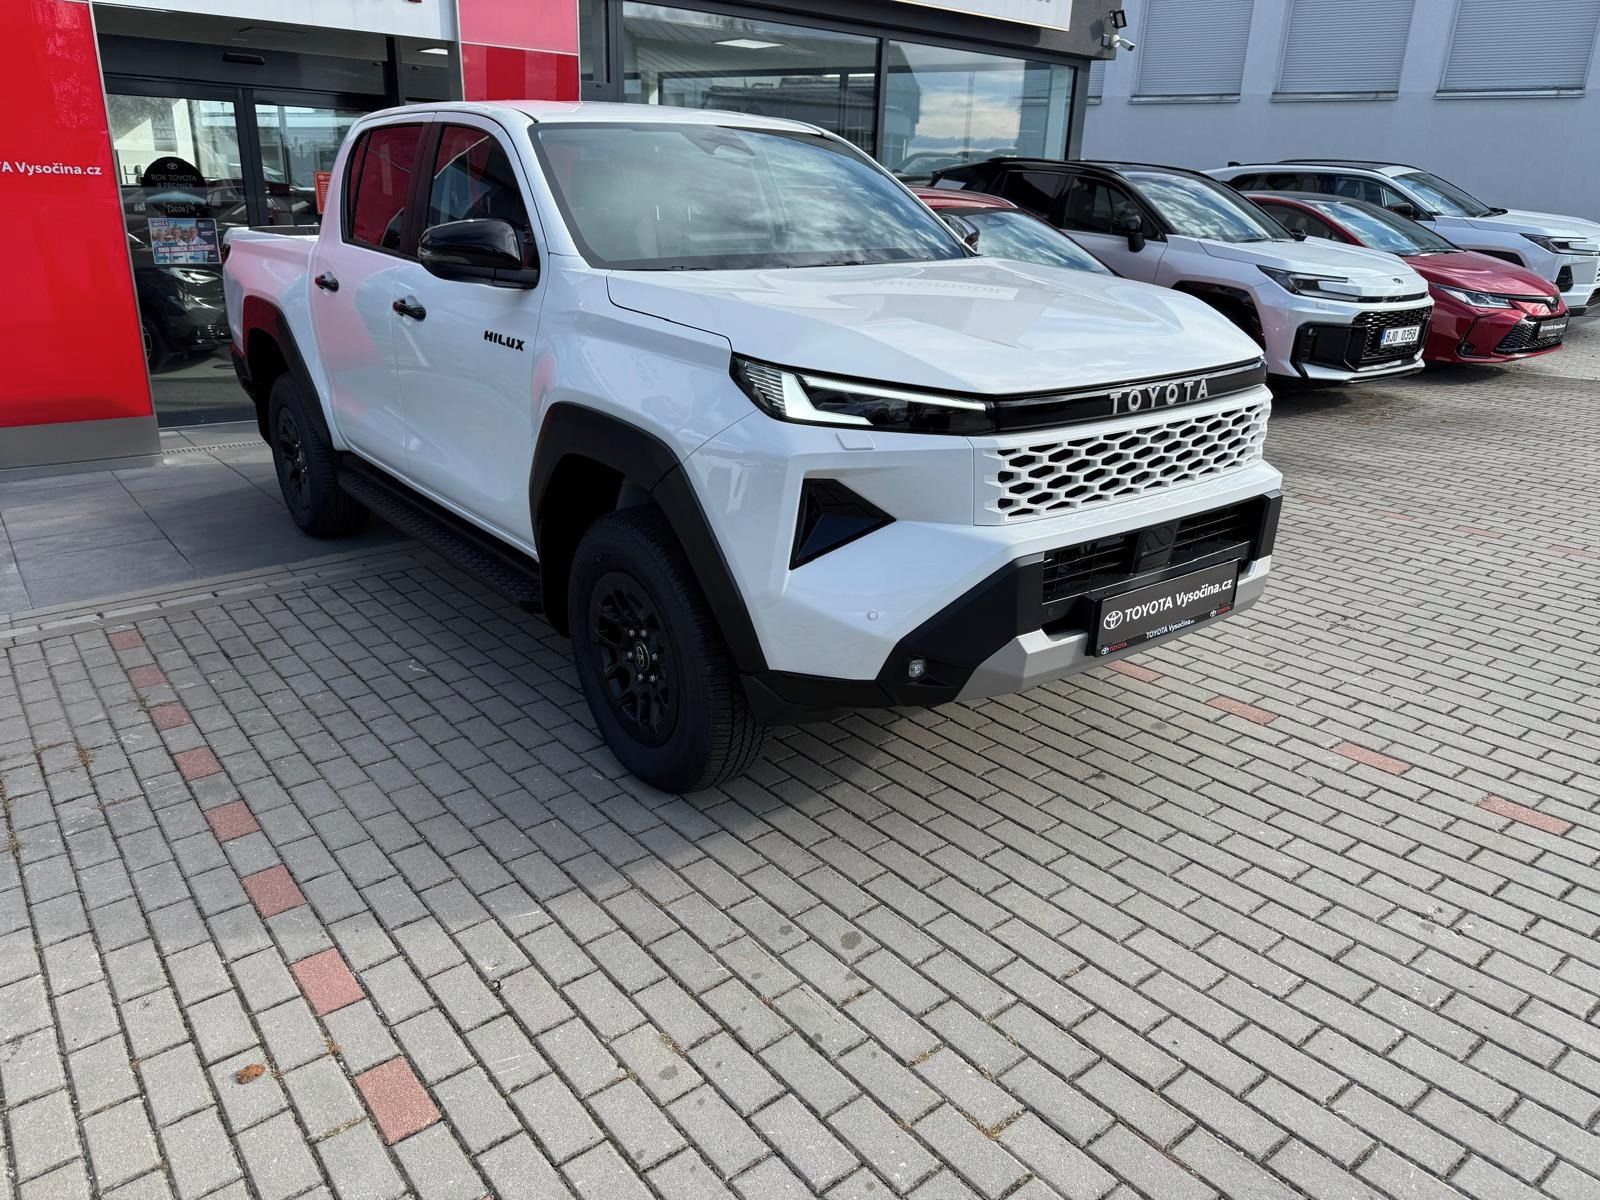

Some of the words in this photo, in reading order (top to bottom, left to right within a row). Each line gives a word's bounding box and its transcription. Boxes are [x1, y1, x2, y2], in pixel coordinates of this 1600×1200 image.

[0, 161, 13, 173] A
[14, 161, 102, 176] Vysočina.cz
[168, 174, 198, 182] TOYOTA
[483, 330, 526, 352] HILUX
[1109, 378, 1209, 415] TOYOTA
[1125, 596, 1173, 622] TOYOTA
[1176, 579, 1232, 607] Vysočina.cz
[1146, 625, 1168, 639] TOYOTA
[1108, 642, 1127, 652] TOYOTA
